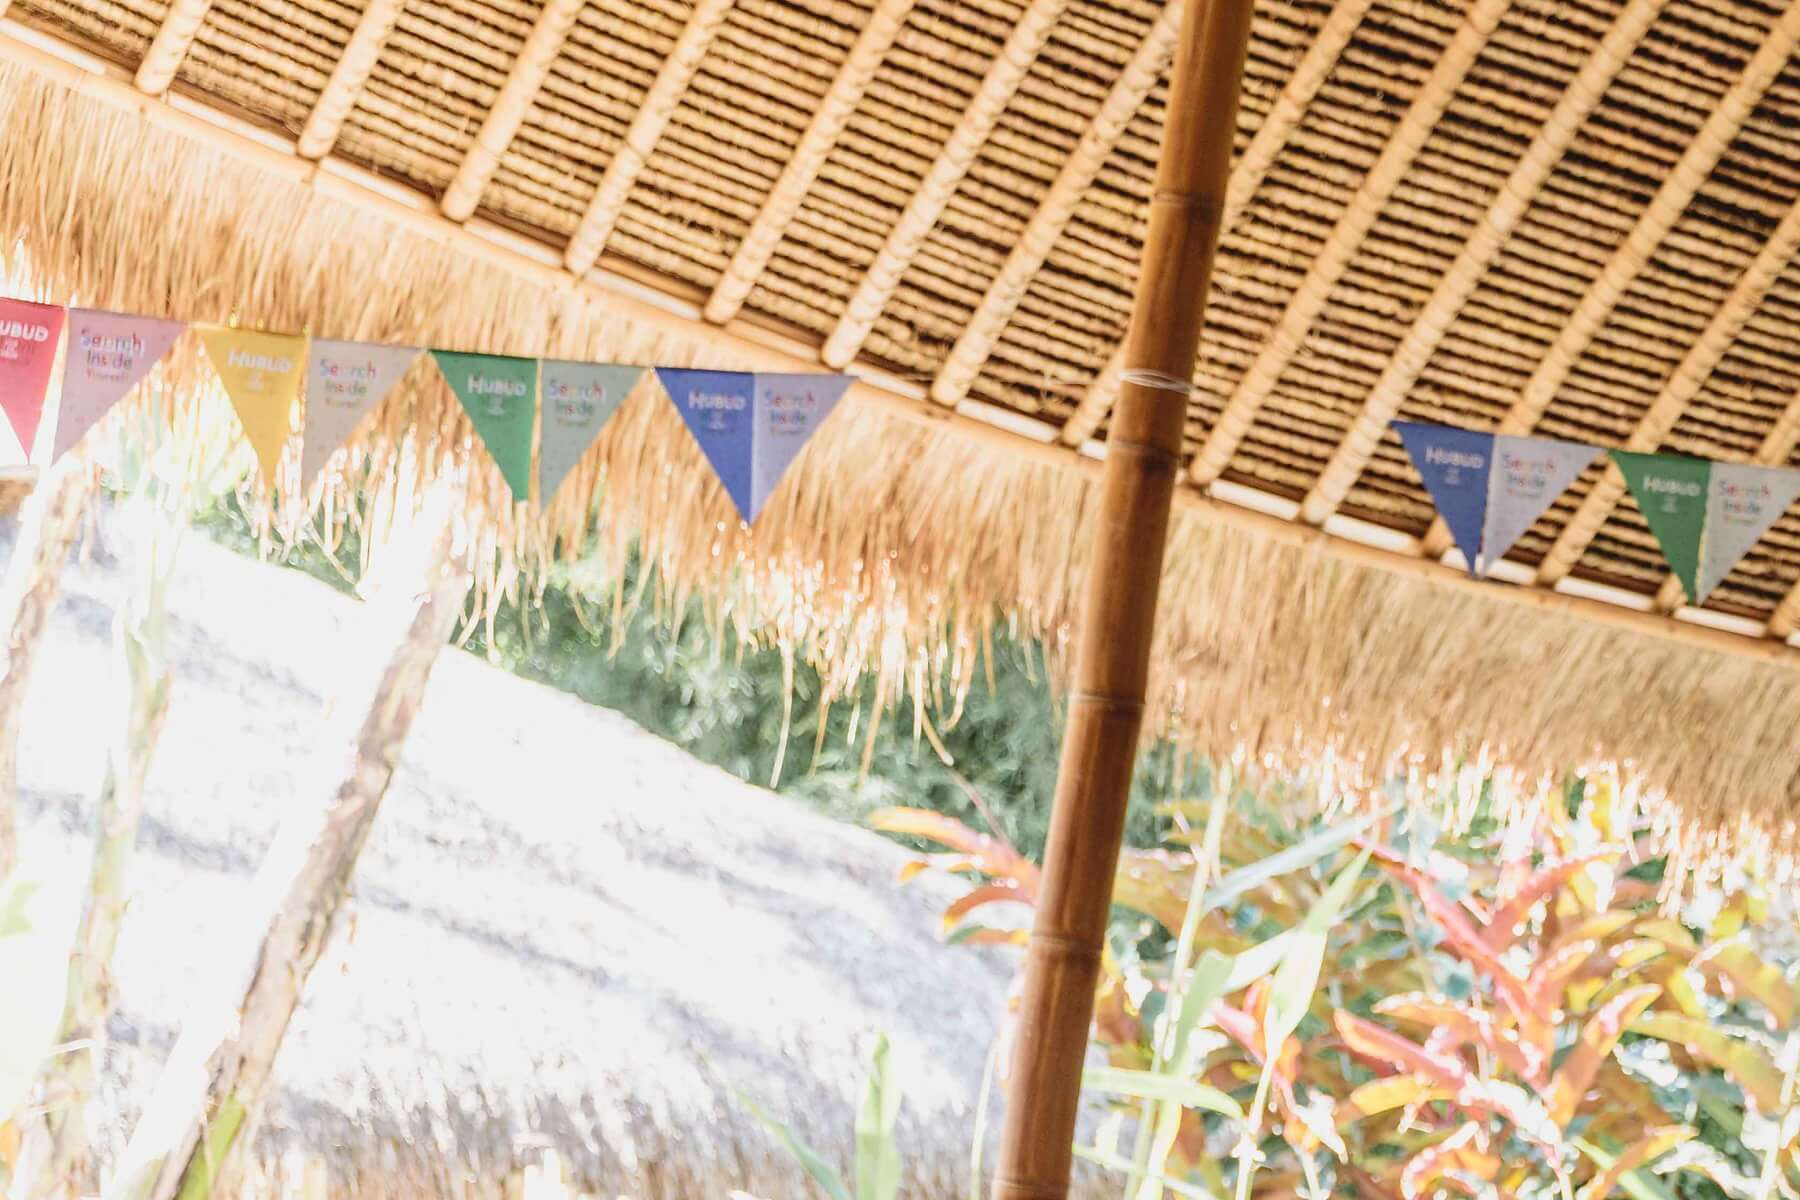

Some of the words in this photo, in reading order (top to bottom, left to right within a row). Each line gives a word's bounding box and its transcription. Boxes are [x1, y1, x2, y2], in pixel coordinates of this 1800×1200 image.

[0, 319, 48, 342] UBUD
[80, 327, 142, 351] Search
[320, 358, 376, 379] Search
[547, 379, 604, 399] Search
[765, 389, 815, 408] Search
